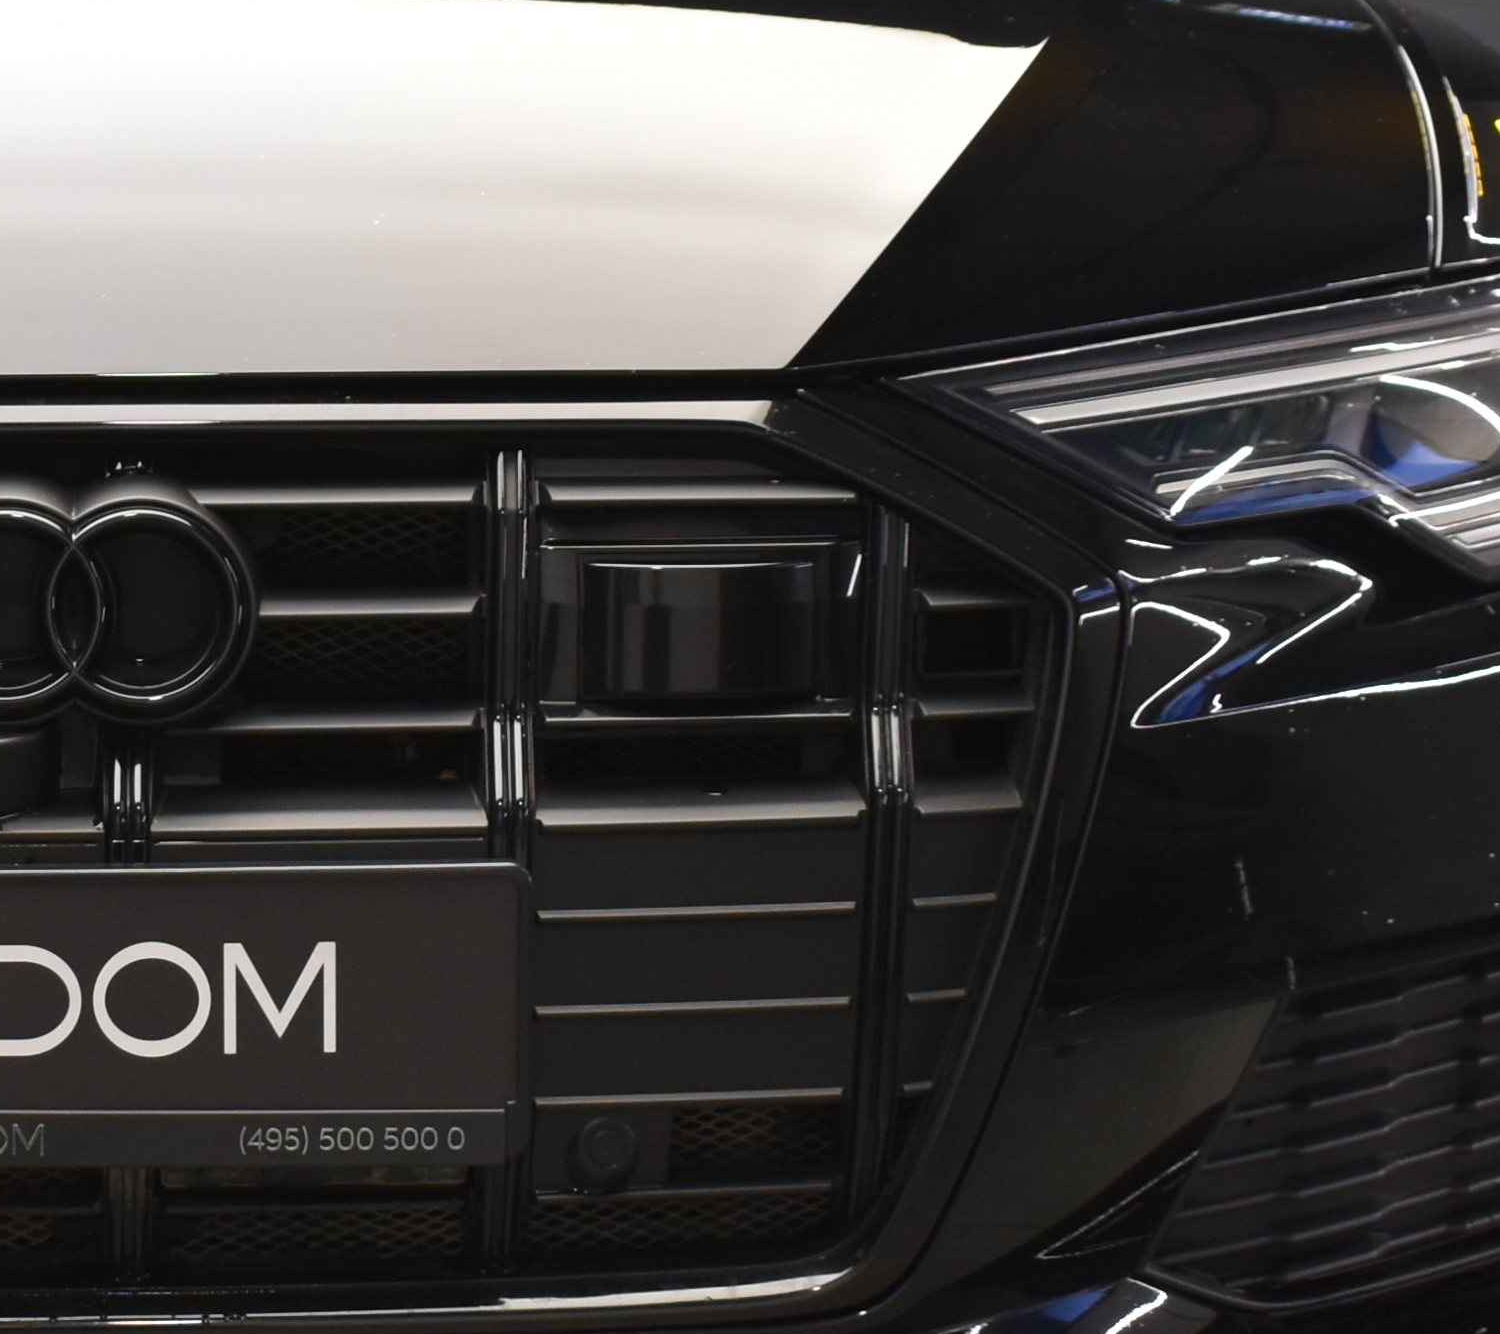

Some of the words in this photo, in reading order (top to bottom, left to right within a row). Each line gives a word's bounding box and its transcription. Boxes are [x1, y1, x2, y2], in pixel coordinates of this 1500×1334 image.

[239, 1125, 309, 1155] (495)
[319, 1127, 374, 1151] 500
[383, 1127, 438, 1151] 500
[447, 1126, 466, 1150] 0
